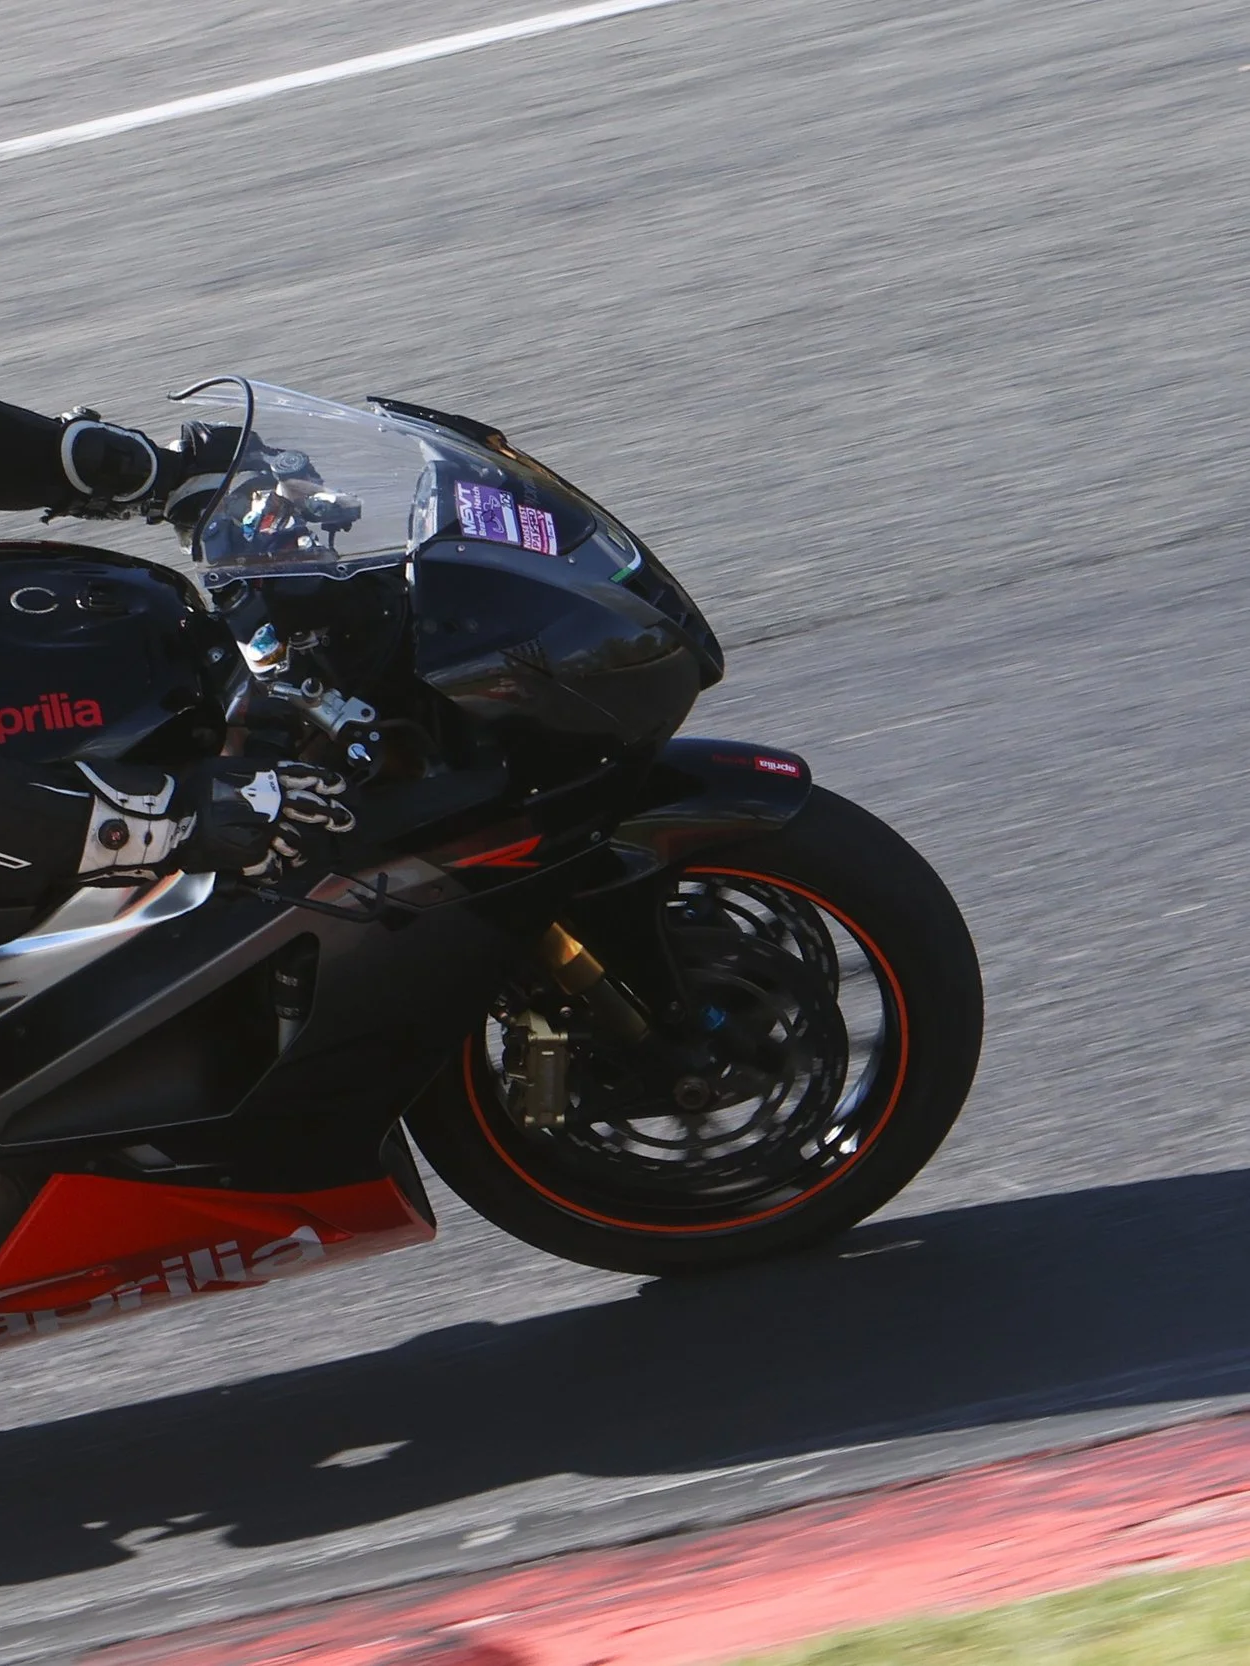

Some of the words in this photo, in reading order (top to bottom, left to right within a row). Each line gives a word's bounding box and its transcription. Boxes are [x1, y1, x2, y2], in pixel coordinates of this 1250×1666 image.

[457, 483, 477, 535] MSVT
[518, 504, 527, 524] TEST
[520, 523, 531, 549] NOISE
[758, 760, 796, 773] aprilia
